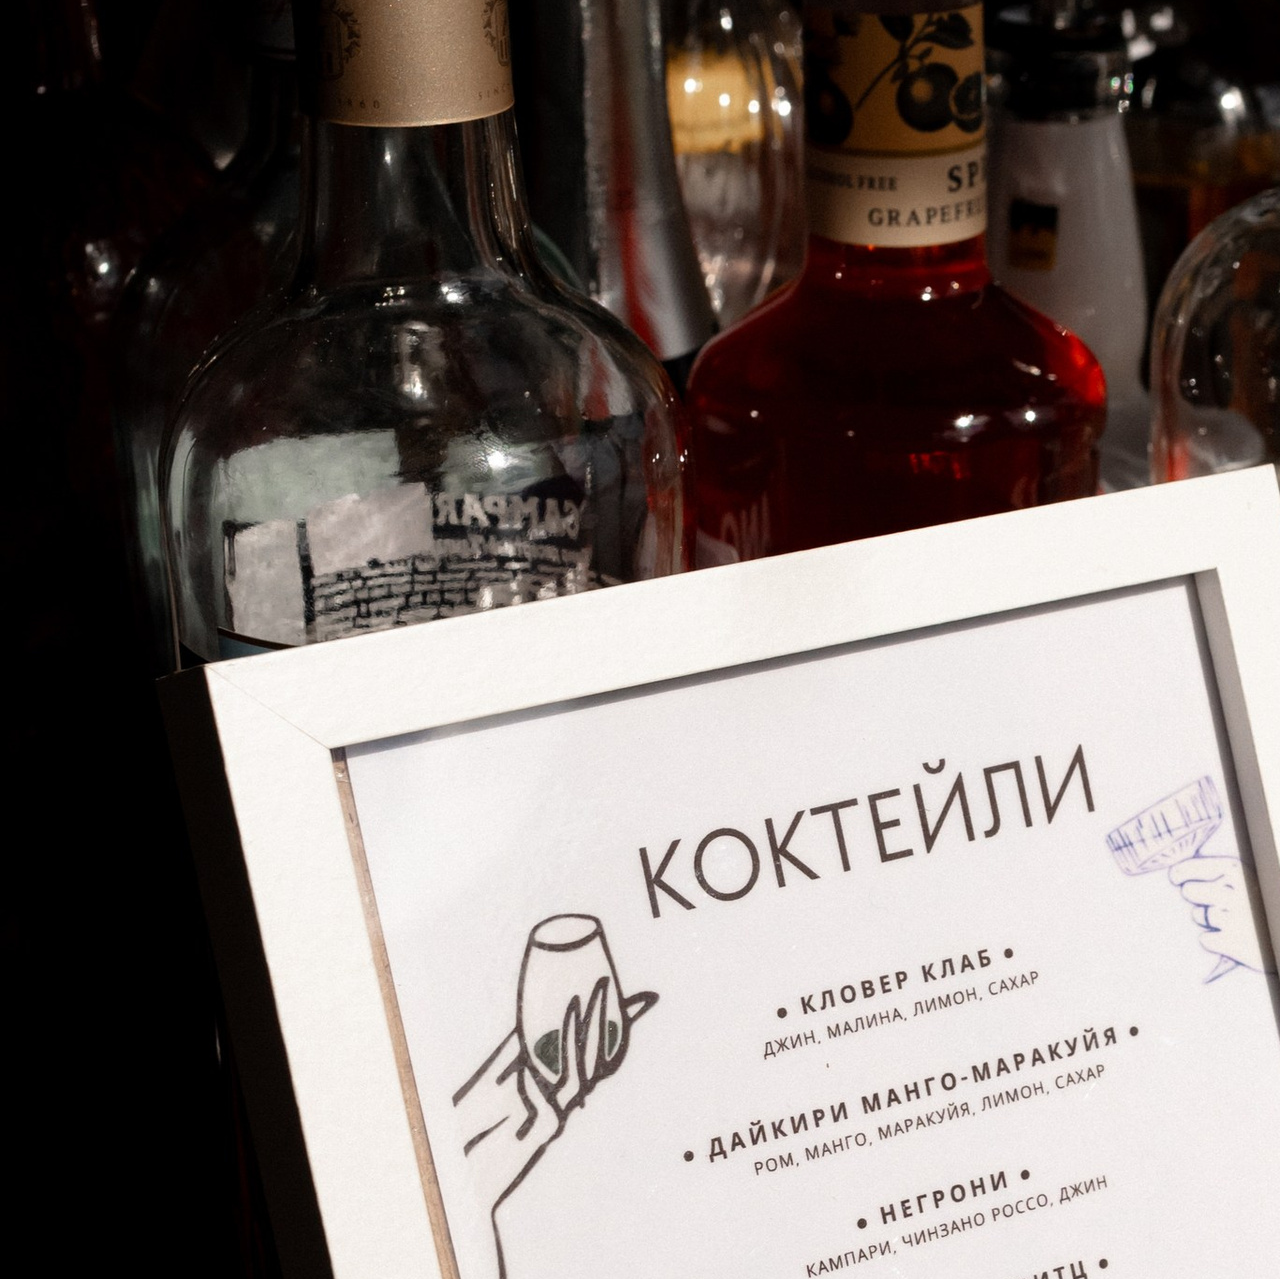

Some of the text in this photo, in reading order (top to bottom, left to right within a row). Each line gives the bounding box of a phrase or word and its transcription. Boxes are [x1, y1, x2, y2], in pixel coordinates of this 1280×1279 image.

[637, 742, 1097, 921] КОКТЕЙЛИ
[762, 969, 1040, 1062] ДЖИН, МАЛИНА, ЛИМОН, САХАР
[799, 947, 993, 1016] КЛОВЕР КЛАБ
[707, 1025, 1118, 1165] ДАЙКИРИ МАНГО-МАРАКУЙЯ
[752, 1063, 1106, 1177] РОМ, МАНГО, МАРАКУЙЯ, ЛИМОН, САХАР
[805, 1174, 1109, 1279] КАМПАРИ, ЧИНЗАНО РОССО, ДЖИН
[878, 1169, 1009, 1226] НЕГРОНИ
